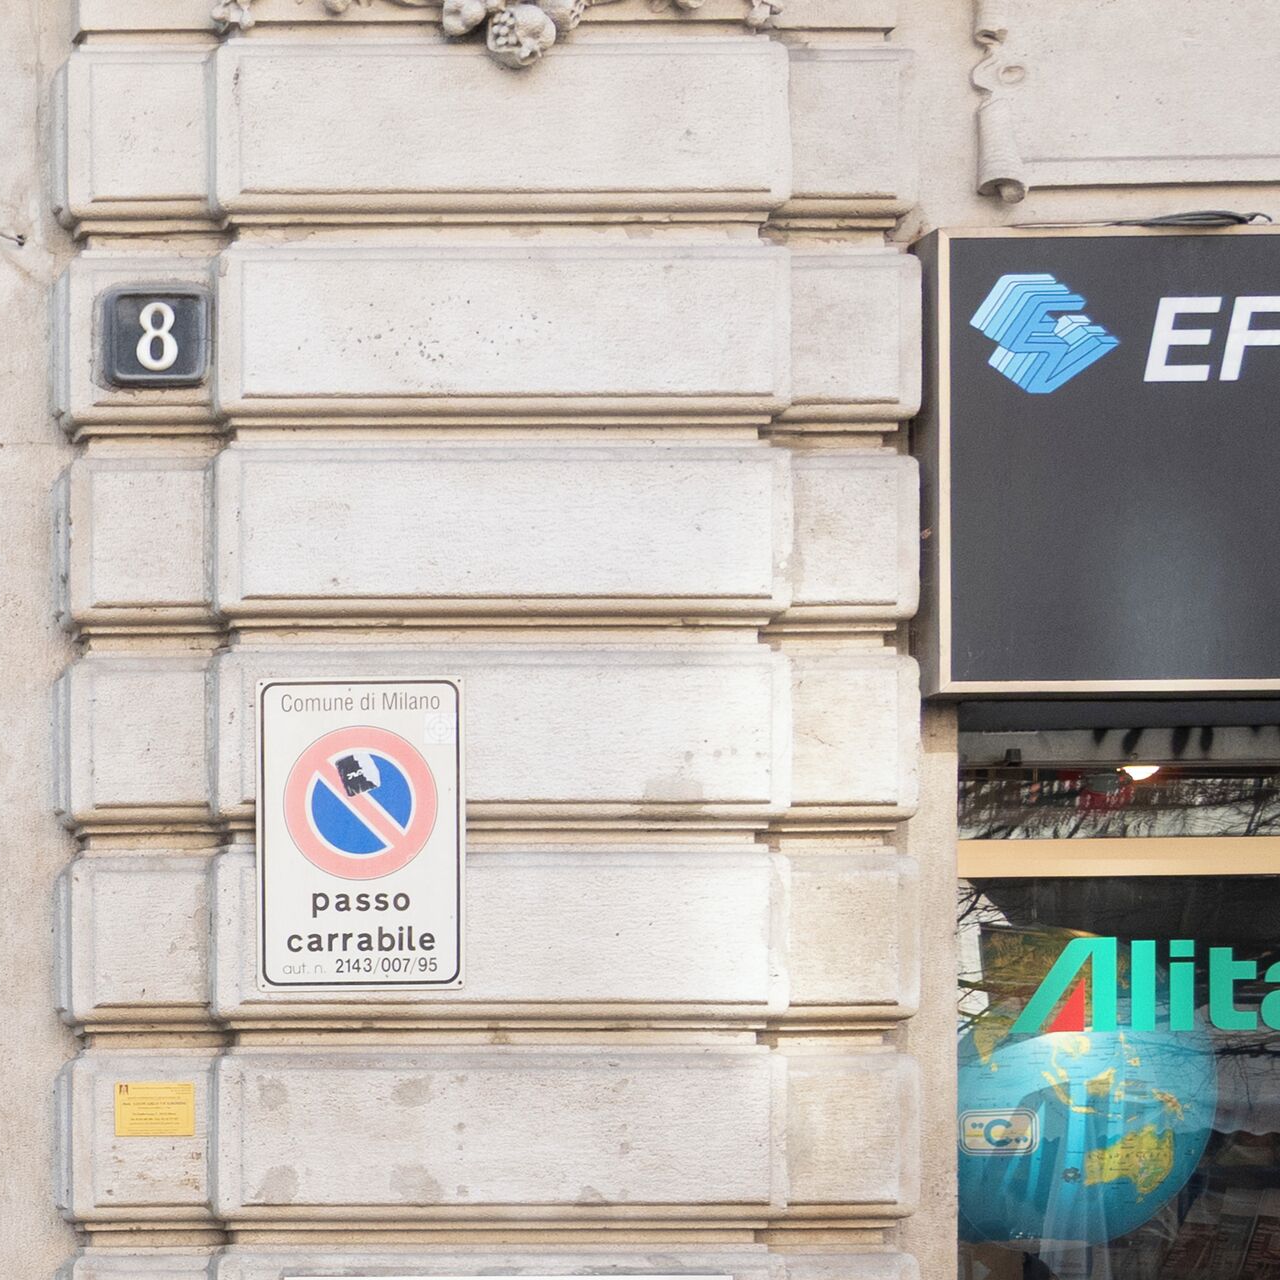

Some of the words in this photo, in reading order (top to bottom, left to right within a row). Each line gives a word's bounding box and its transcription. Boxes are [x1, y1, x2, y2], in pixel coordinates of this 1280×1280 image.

[136, 302, 178, 371] 8
[281, 693, 354, 713] Comune
[360, 692, 375, 711] di
[382, 691, 441, 711] Milano
[312, 891, 411, 918] passo
[287, 926, 436, 952] carrabile
[335, 956, 438, 975] 2143/007/95
